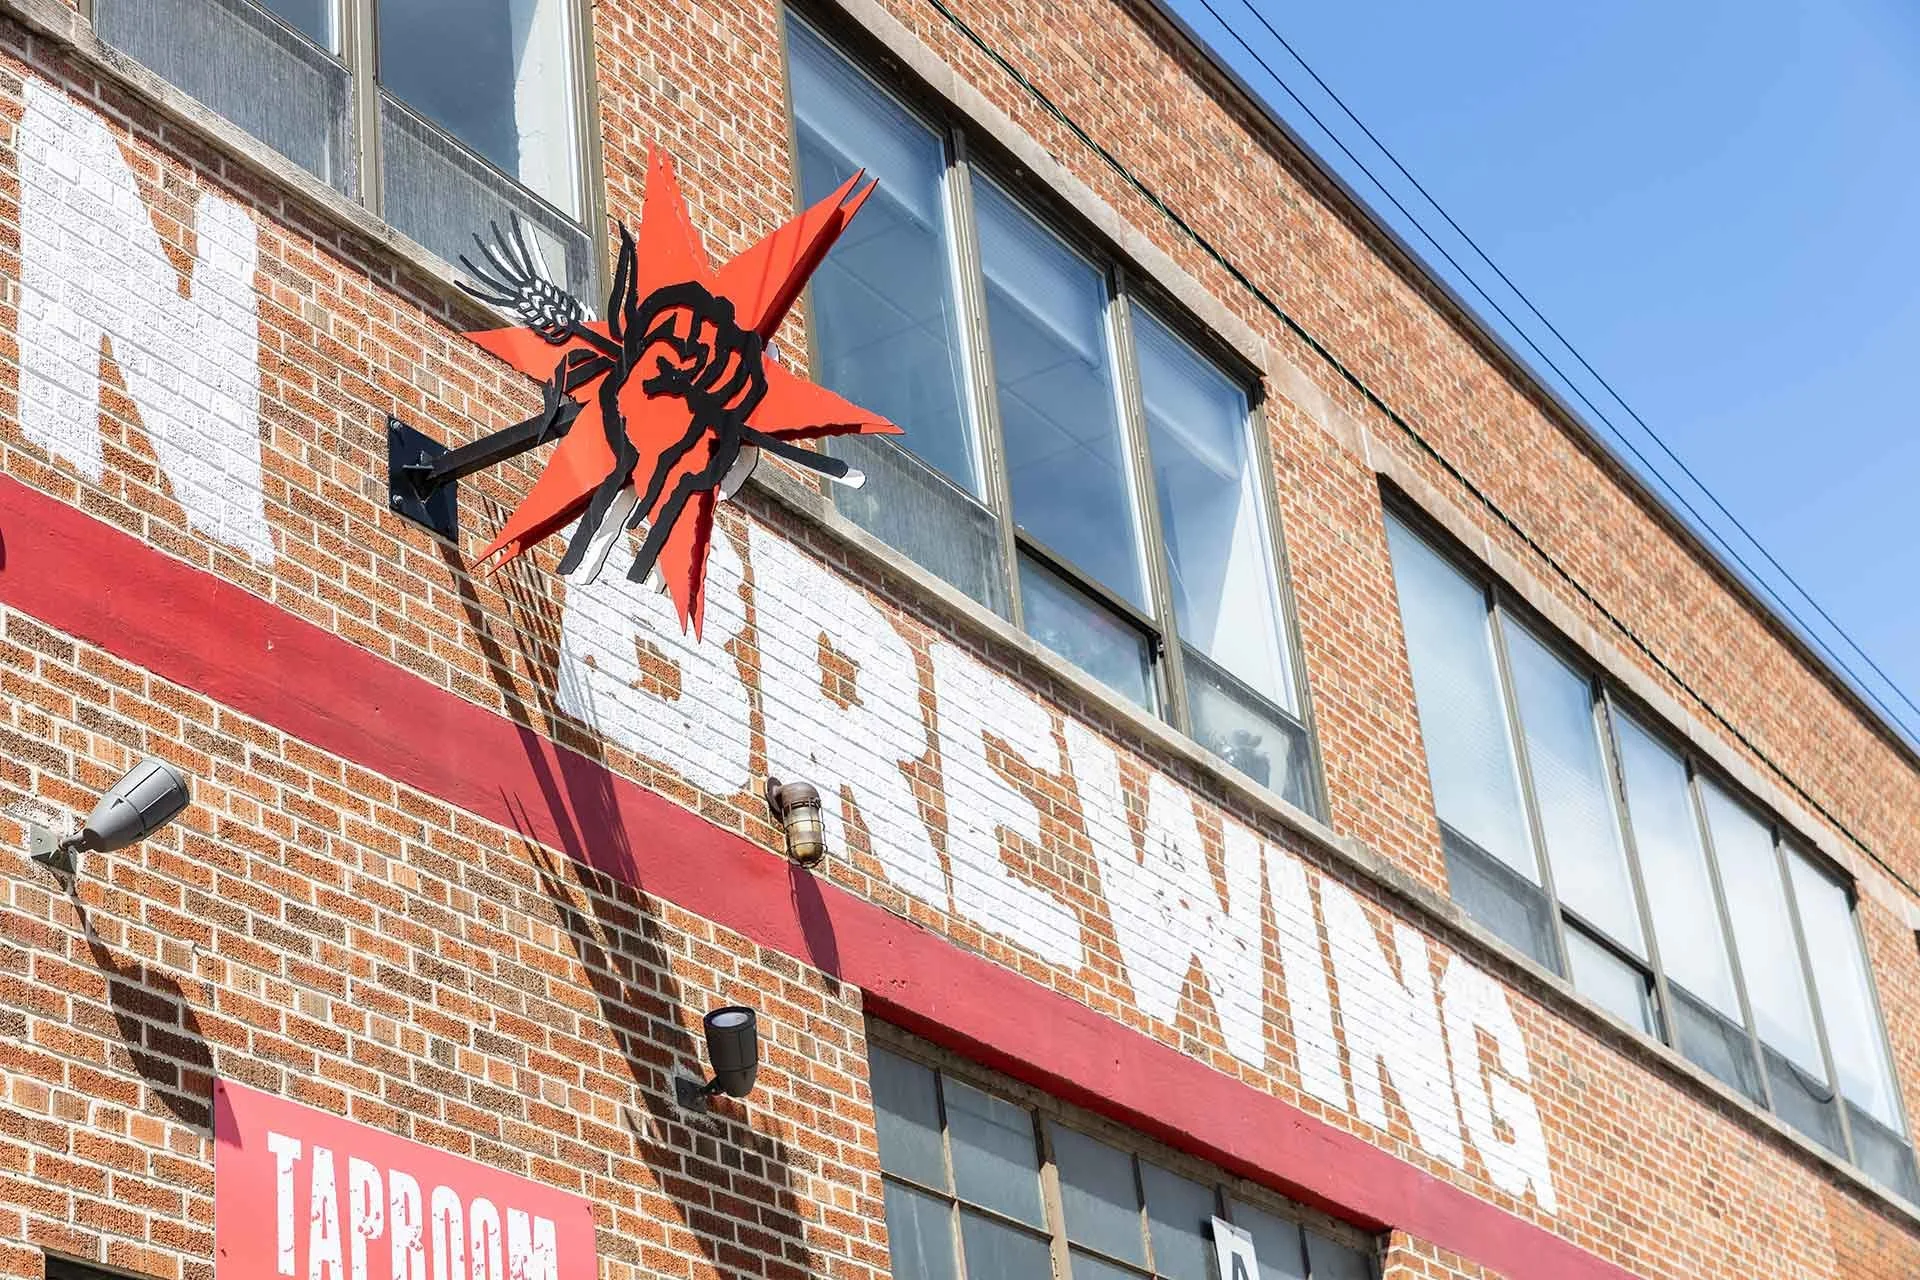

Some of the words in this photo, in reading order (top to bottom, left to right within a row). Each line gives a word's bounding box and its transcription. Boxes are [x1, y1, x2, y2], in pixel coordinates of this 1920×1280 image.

[17, 76, 275, 566] N
[555, 505, 1558, 1217] BREWING
[266, 1130, 560, 1280] TAPROOM
